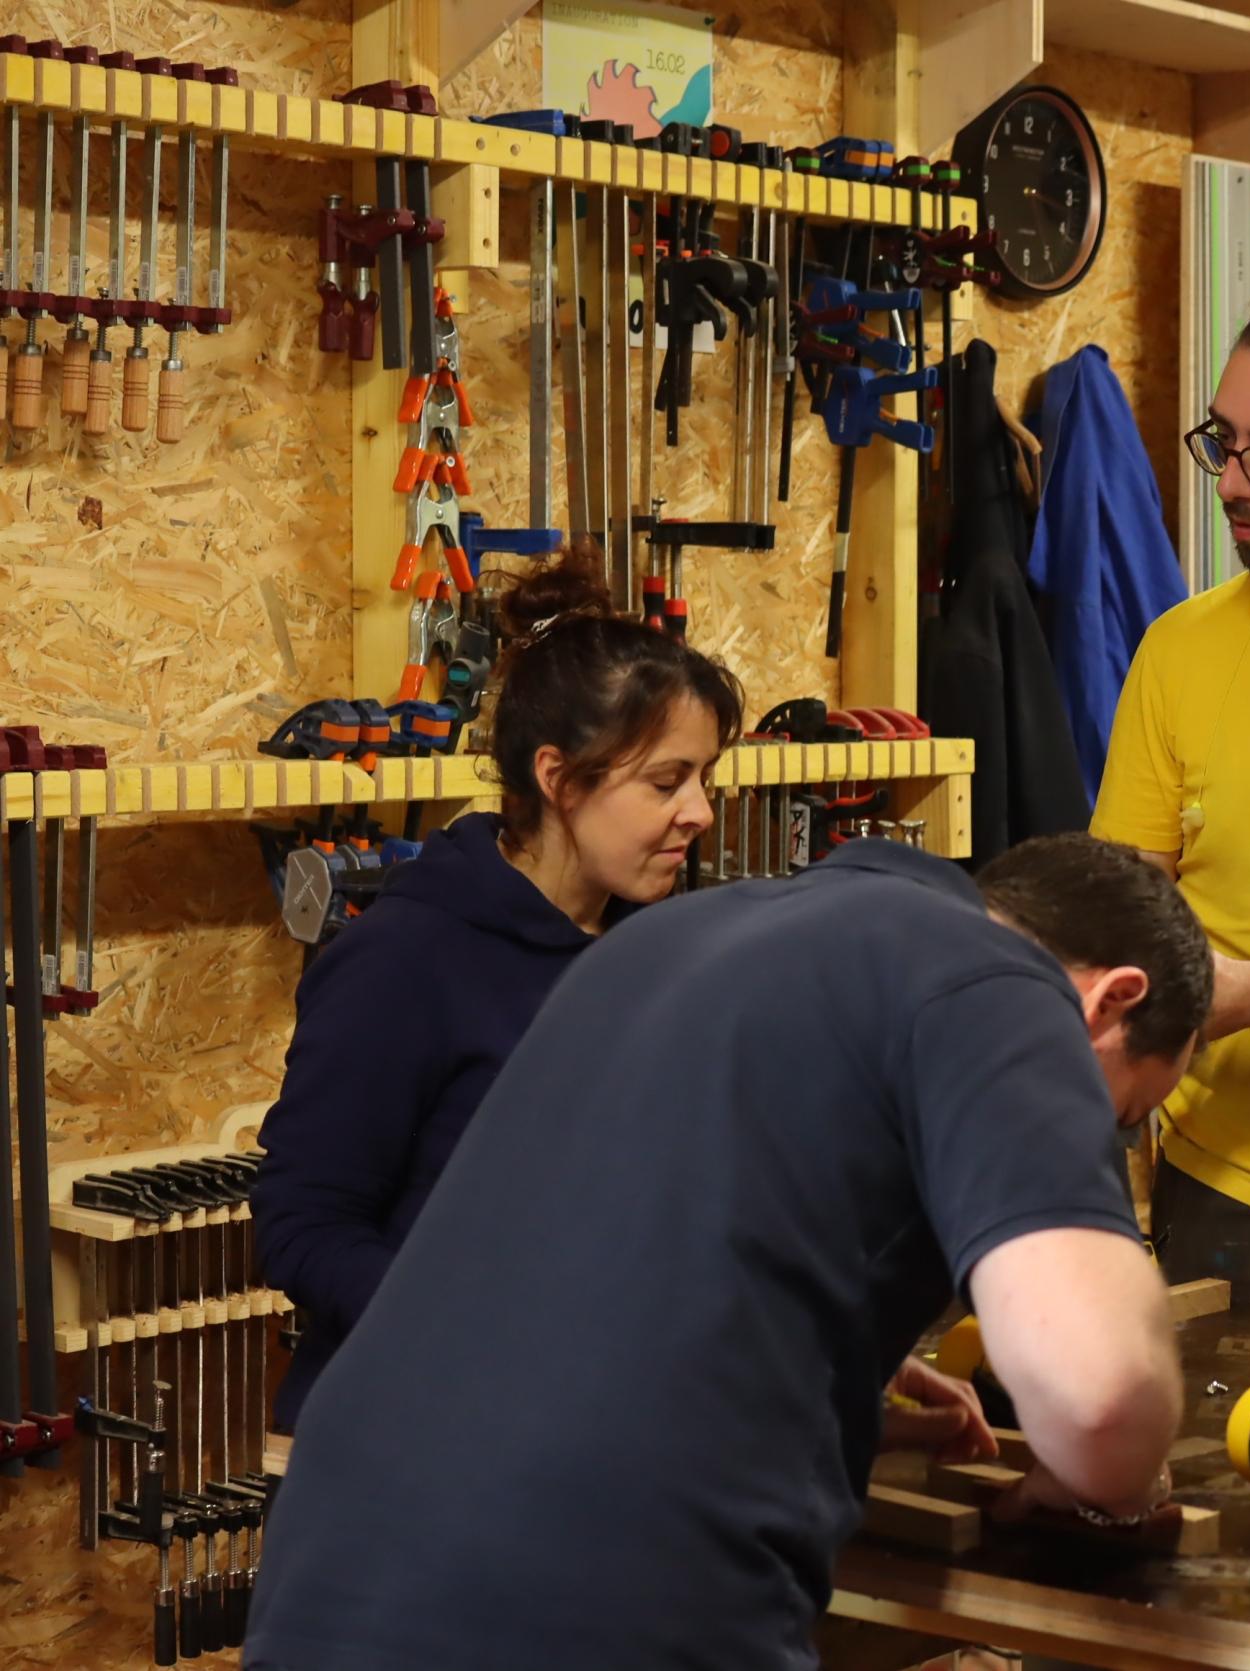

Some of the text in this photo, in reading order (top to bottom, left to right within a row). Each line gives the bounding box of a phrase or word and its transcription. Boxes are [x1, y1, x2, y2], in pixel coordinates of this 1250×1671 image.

[645, 48, 686, 75] 16.02
[1023, 115, 1035, 135] 12
[1060, 156, 1067, 171] 2
[1065, 188, 1073, 207] 3
[1023, 248, 1031, 267] 6
